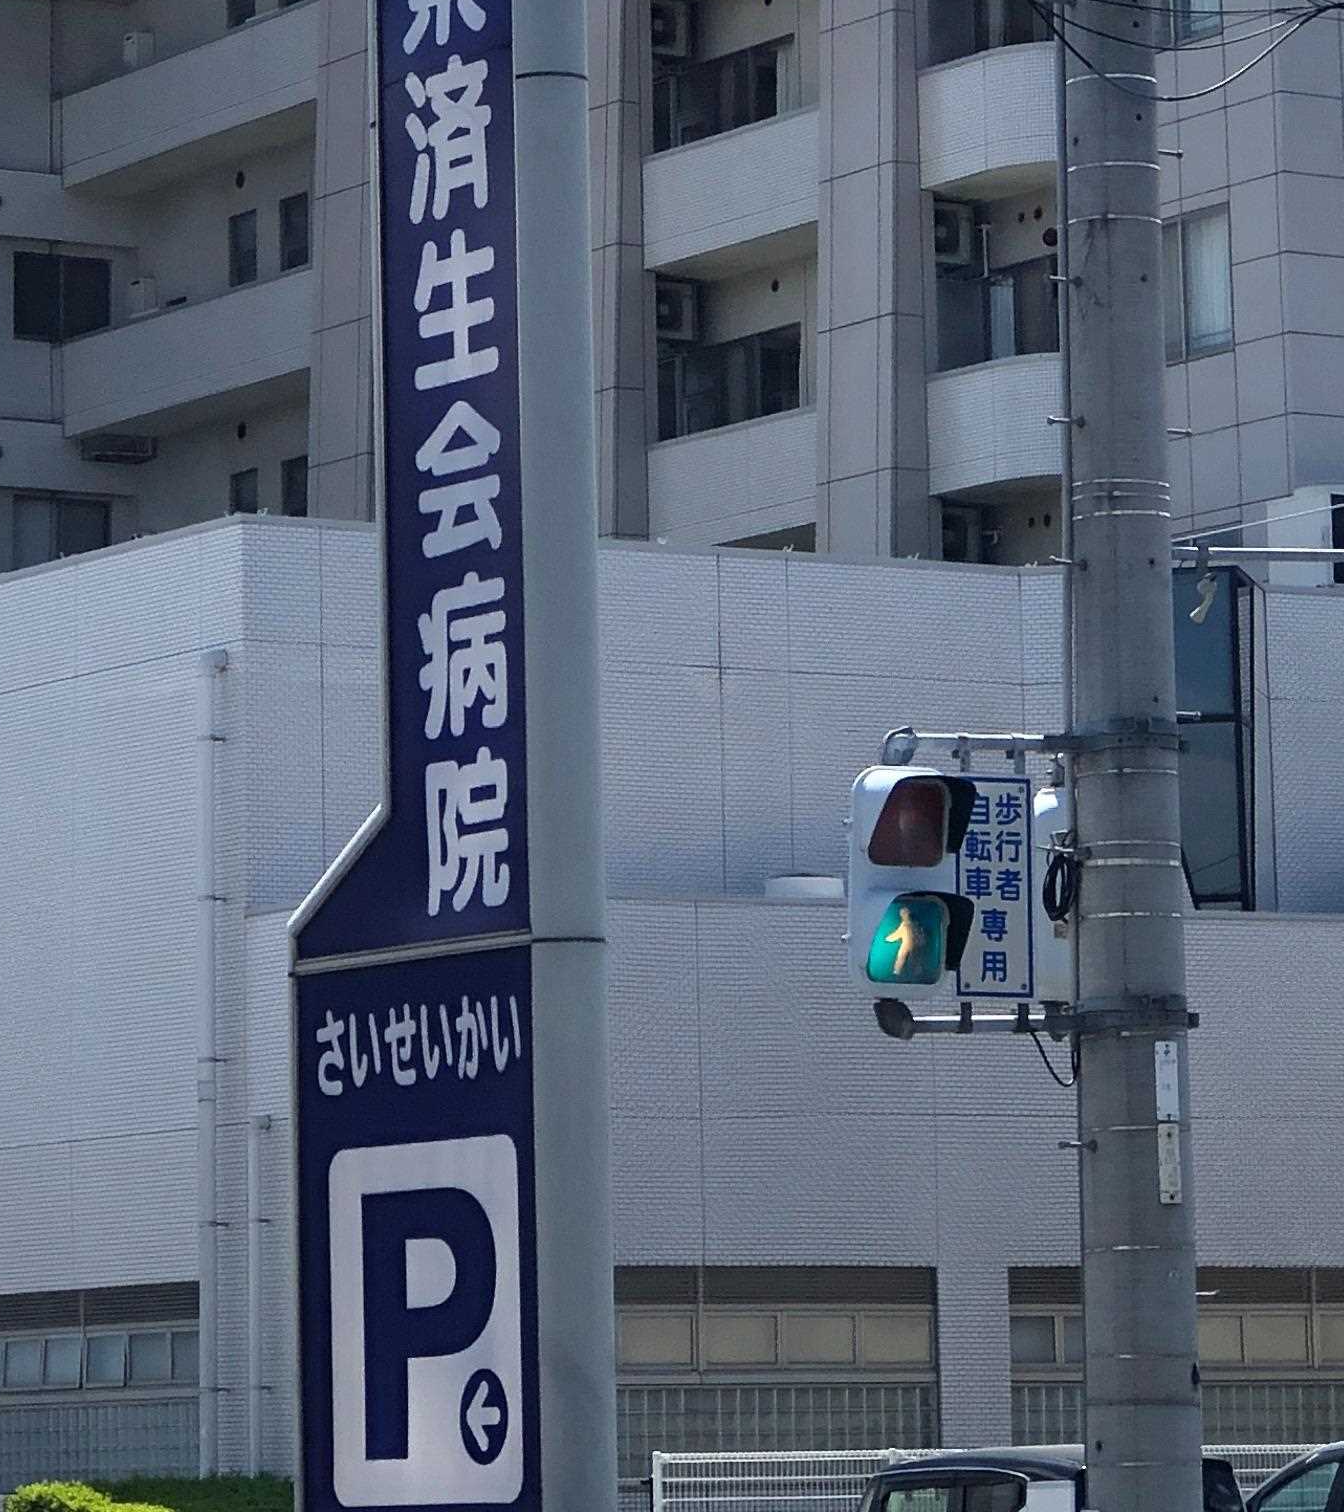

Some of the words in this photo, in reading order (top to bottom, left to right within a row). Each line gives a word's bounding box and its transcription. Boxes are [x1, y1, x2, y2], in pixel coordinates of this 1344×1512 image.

[963, 794, 993, 900] 自転車
[995, 793, 1023, 902] 歩行者
[980, 908, 1008, 983] 専用
[315, 995, 522, 1097] さいせいかい
[360, 1186, 497, 1461] P
